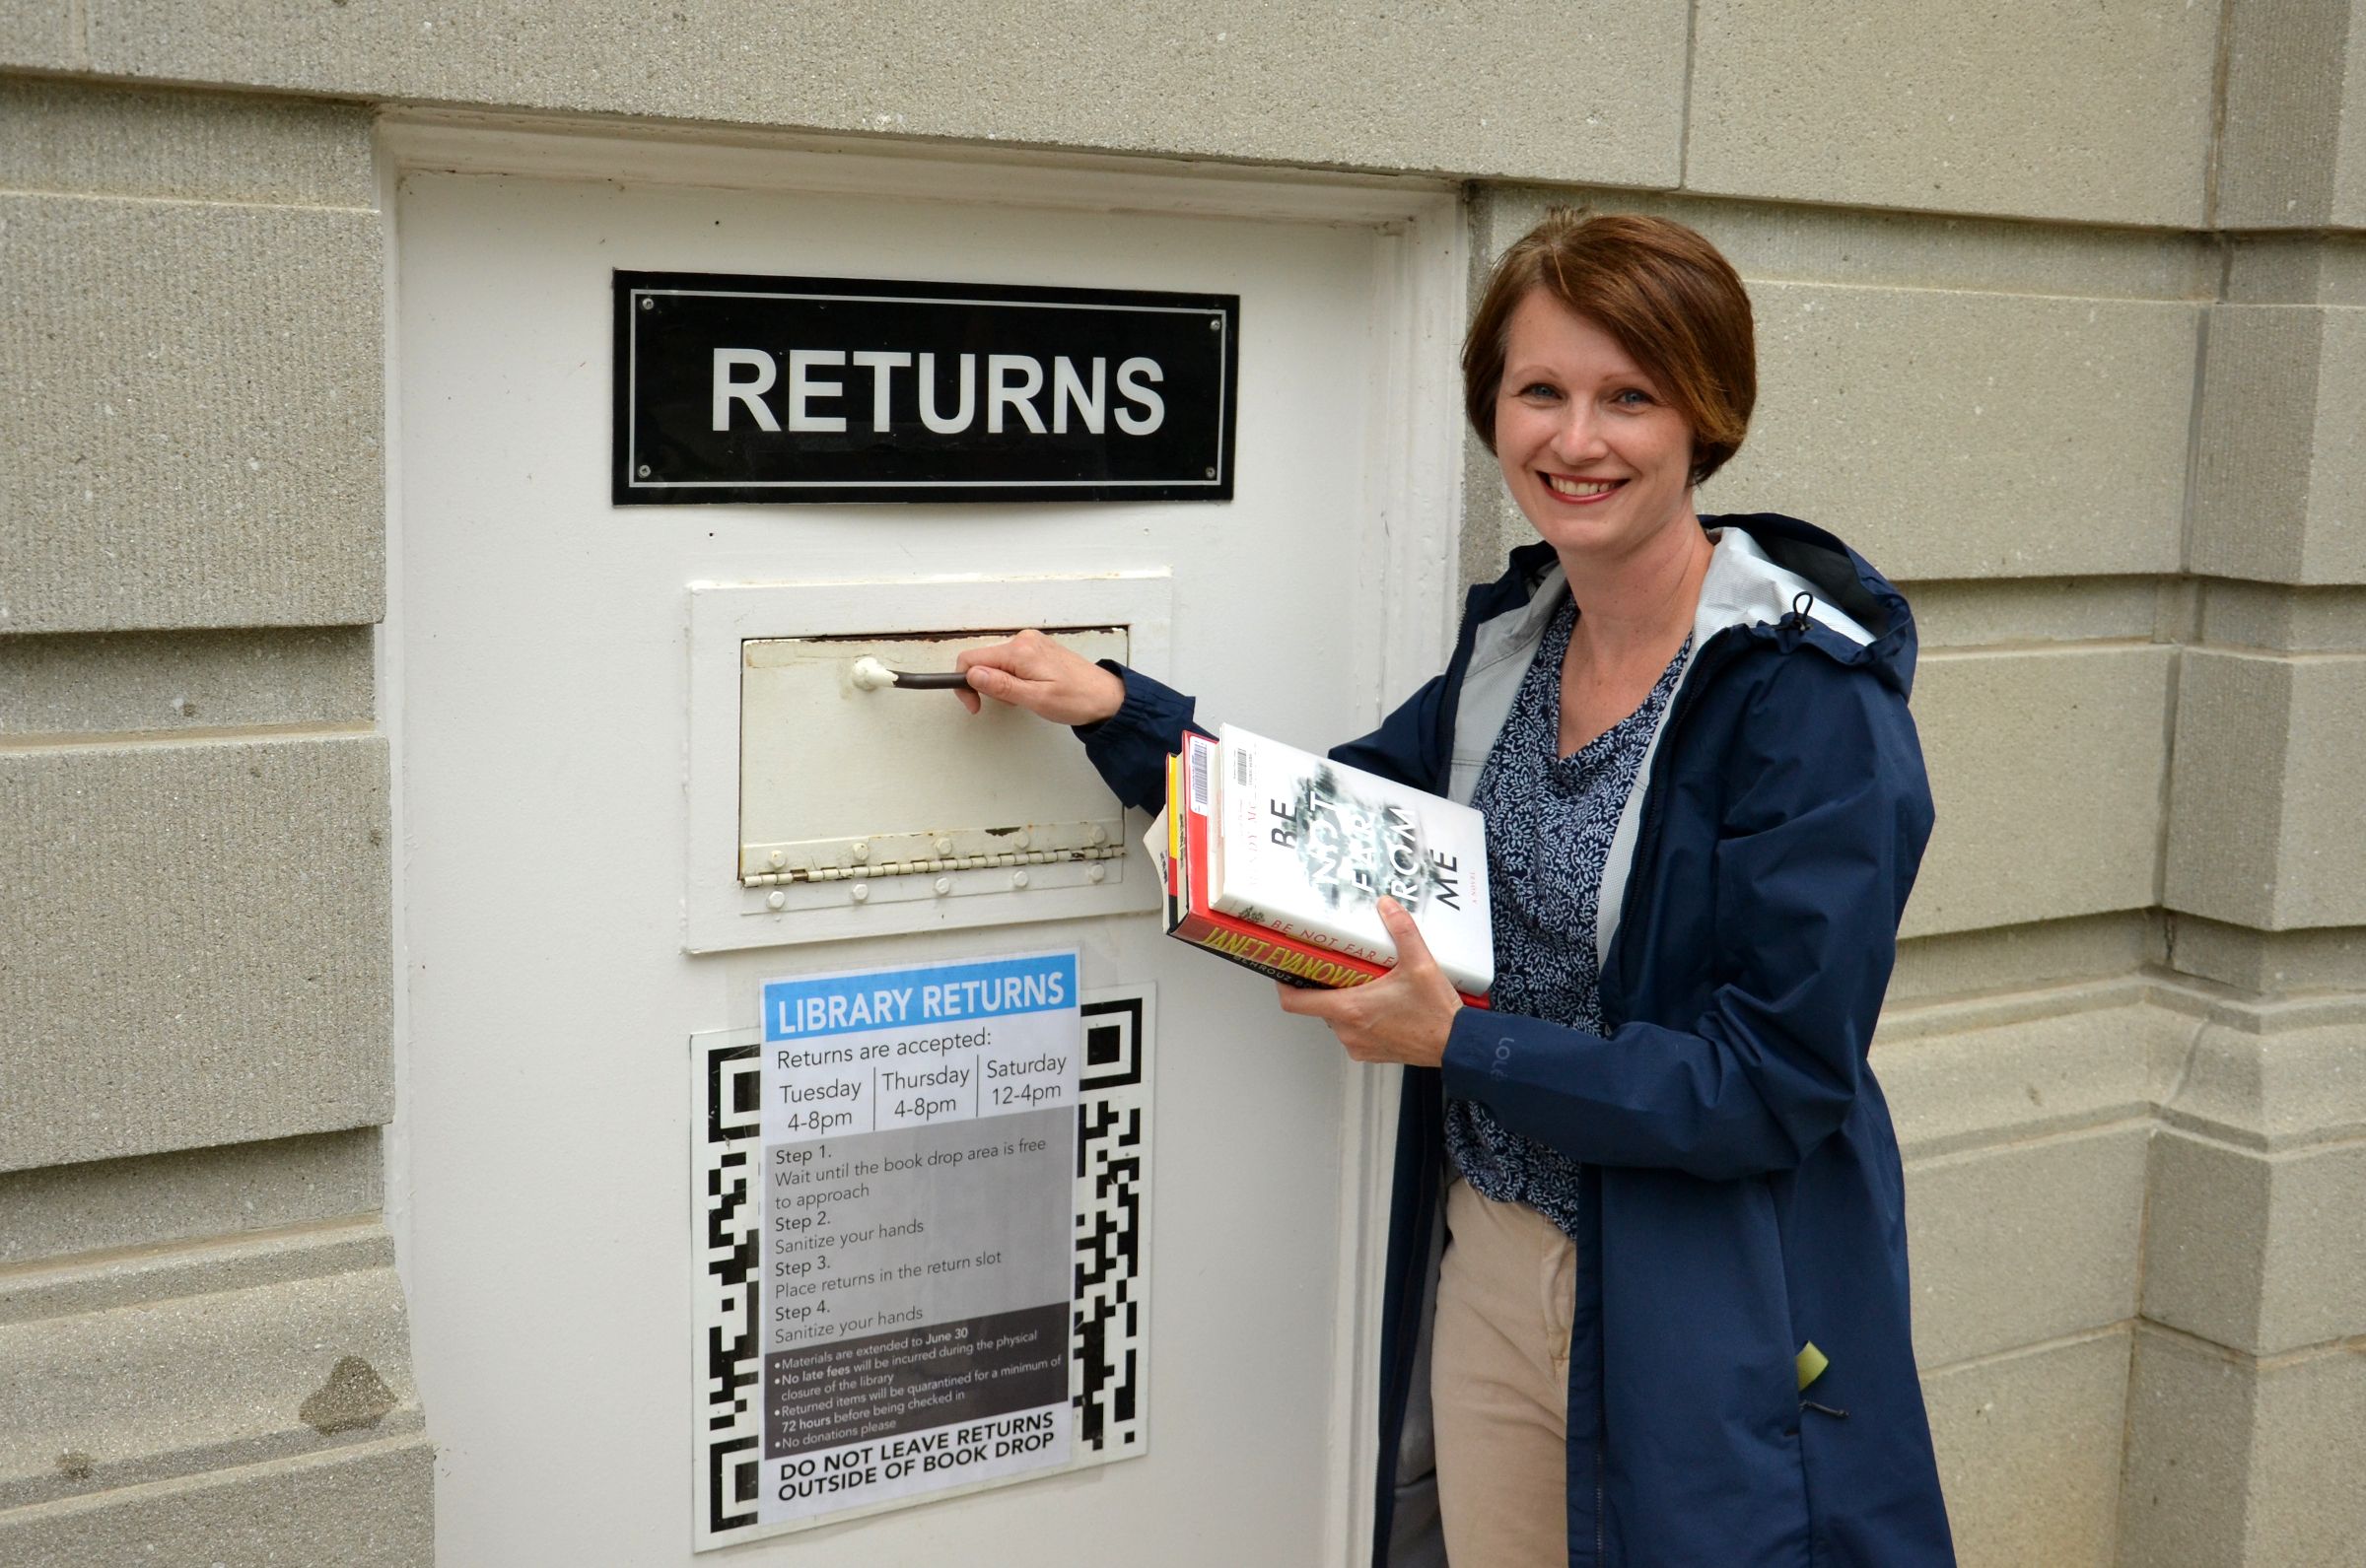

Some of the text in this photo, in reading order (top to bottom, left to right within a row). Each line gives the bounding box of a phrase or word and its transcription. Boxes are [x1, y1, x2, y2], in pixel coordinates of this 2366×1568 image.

[712, 347, 1165, 436] RETURNS
[1271, 798, 1297, 849] BE
[1309, 789, 1339, 885] NOT
[1351, 811, 1376, 893] FAR
[1428, 849, 1460, 911] ME
[1202, 926, 1270, 961] JANET
[1272, 920, 1293, 933] BE
[1300, 929, 1338, 947] NOT
[1343, 943, 1376, 961] FAR
[1233, 955, 1291, 982] BEHROUZ
[778, 971, 1065, 1034] LIBRARY RETURNS
[777, 1027, 991, 1069] Returns are accepted:
[987, 1053, 1067, 1078] Saturday
[780, 1079, 862, 1105] Tuesday
[882, 1065, 970, 1092] Thursday
[992, 1083, 1062, 1107] 12-4pm
[788, 1110, 852, 1134] 4-8pm
[894, 1096, 956, 1121] 4-8pm
[775, 1144, 831, 1167] Step 1.
[775, 1137, 1046, 1188] Wait until the book drop area is free
[775, 1183, 870, 1210] to approach
[775, 1210, 831, 1234] Step 2.
[775, 1218, 925, 1255] Sanitize your hands
[775, 1255, 830, 1278] Step 3.
[775, 1250, 1002, 1299] Place returns in the return slot
[775, 1299, 830, 1324] Step 4.
[775, 1306, 924, 1344] Sanitize your hands
[782, 1327, 969, 1370] Materials are extended to June 30
[782, 1329, 1038, 1386] No late fees will be incurred during the physical
[781, 1373, 894, 1401] closure of the library
[782, 1354, 1062, 1417] Returned items will be quarantined for a minimum of
[782, 1391, 965, 1433] 72 hours before being checked in
[780, 1410, 1054, 1481] DO NOT LEAVE RETURNS
[782, 1419, 897, 1449] No donations please
[778, 1431, 1055, 1501] OUTSIDE OF BOOK DROP
